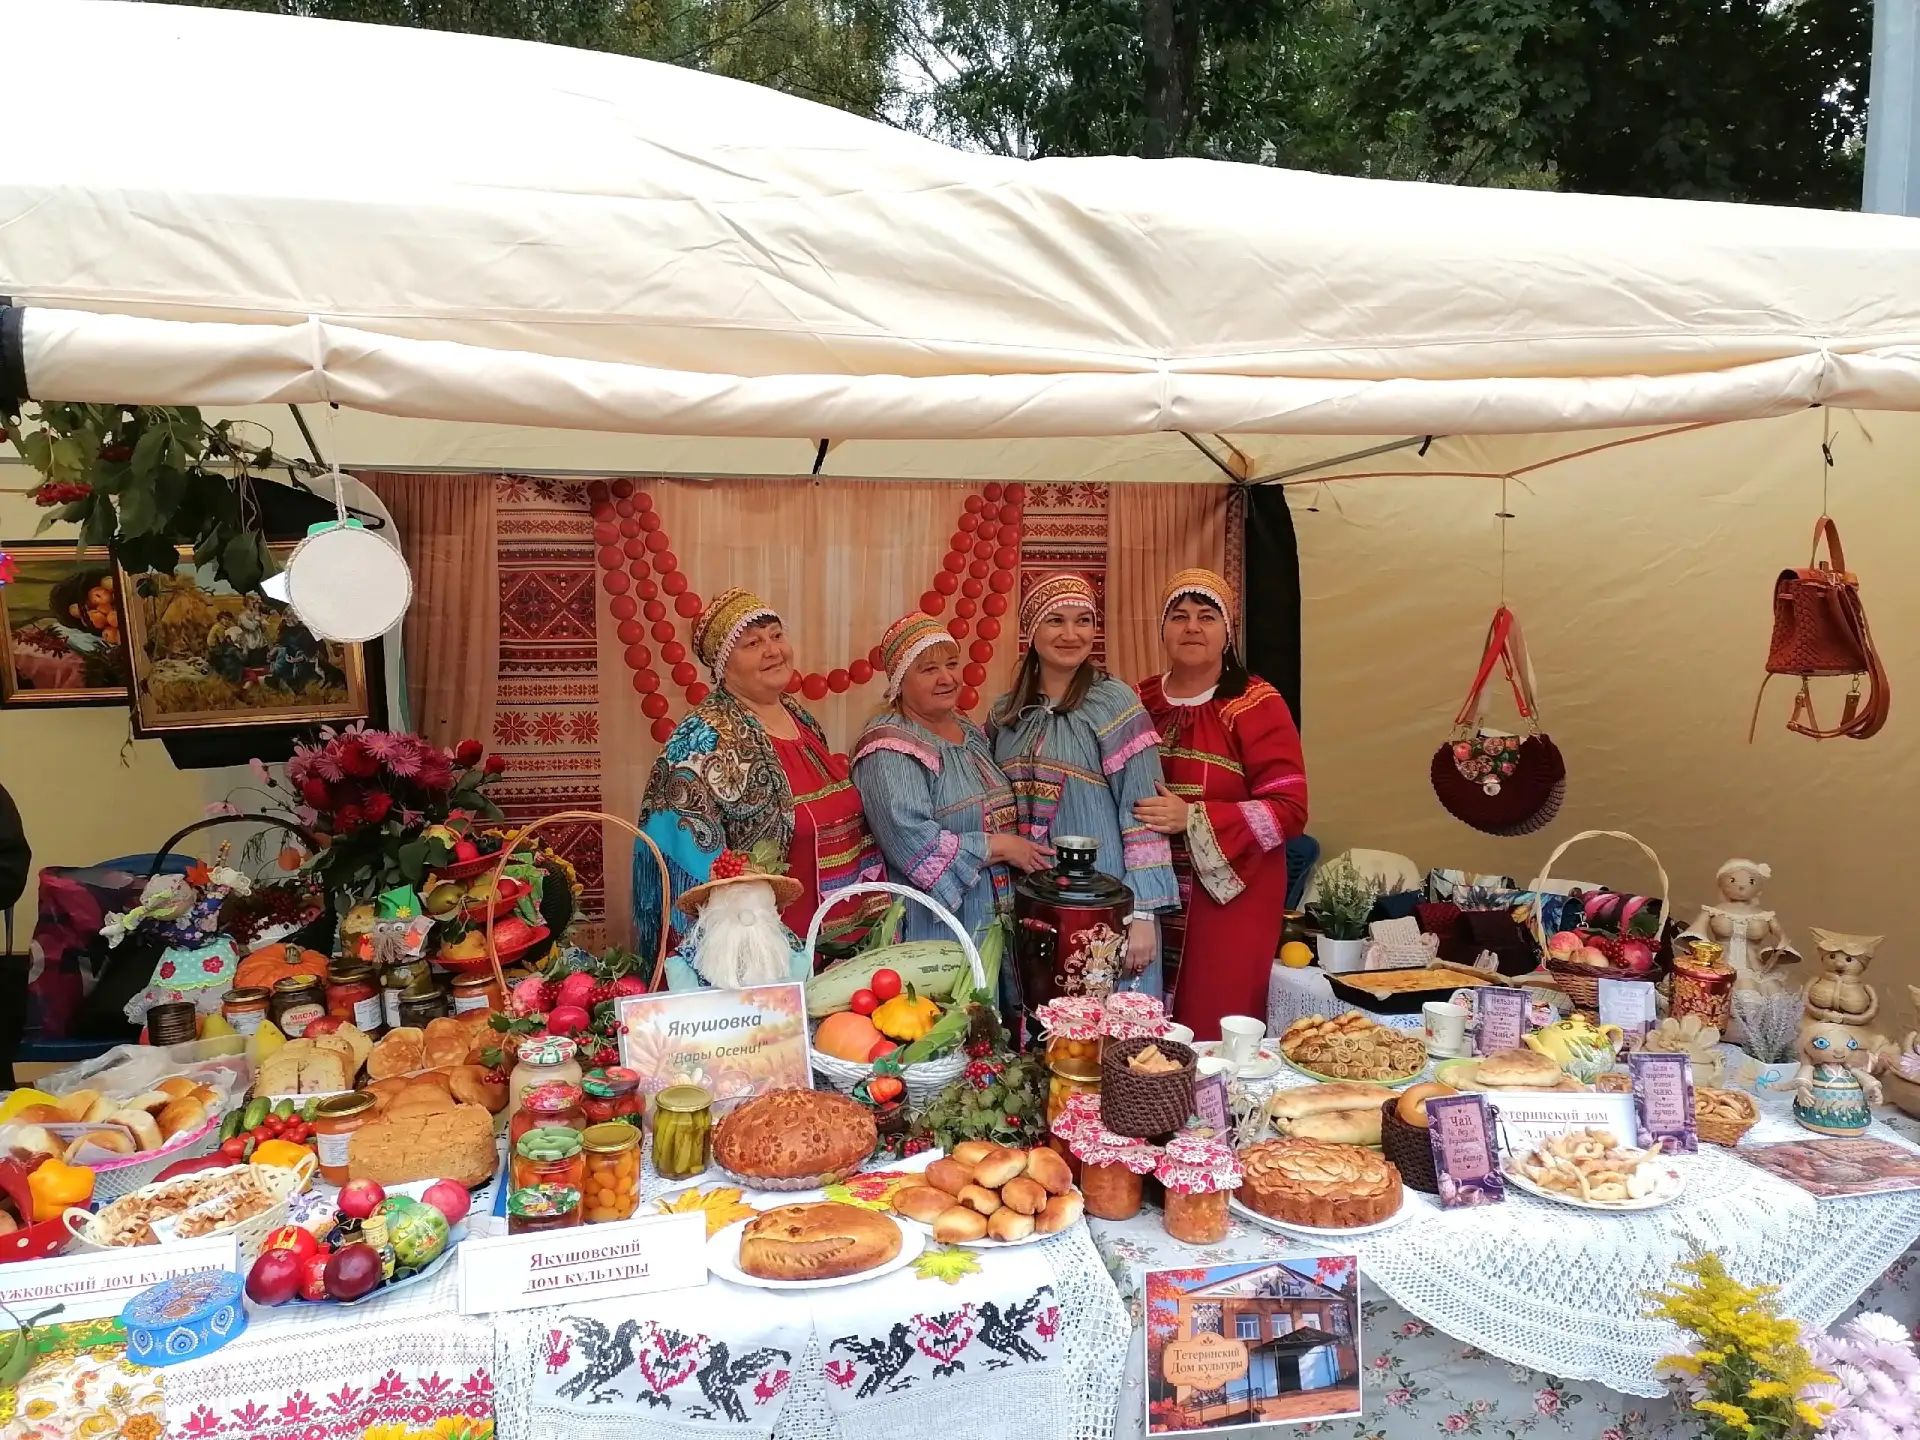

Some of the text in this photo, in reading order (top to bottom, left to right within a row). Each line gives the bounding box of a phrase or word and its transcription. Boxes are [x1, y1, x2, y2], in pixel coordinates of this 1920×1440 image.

[668, 1014, 763, 1038] Якушовка
[668, 1041, 769, 1066] "Дары Осени!"
[1450, 1114, 1473, 1127] Чай
[1500, 1109, 1608, 1121] теринский дом
[530, 1239, 641, 1269] Якушовский
[100, 1272, 134, 1289] дом
[526, 1262, 649, 1291] дом культуры
[1172, 1347, 1240, 1361] Тетеринский
[1170, 1361, 1243, 1375] Дом культуры
